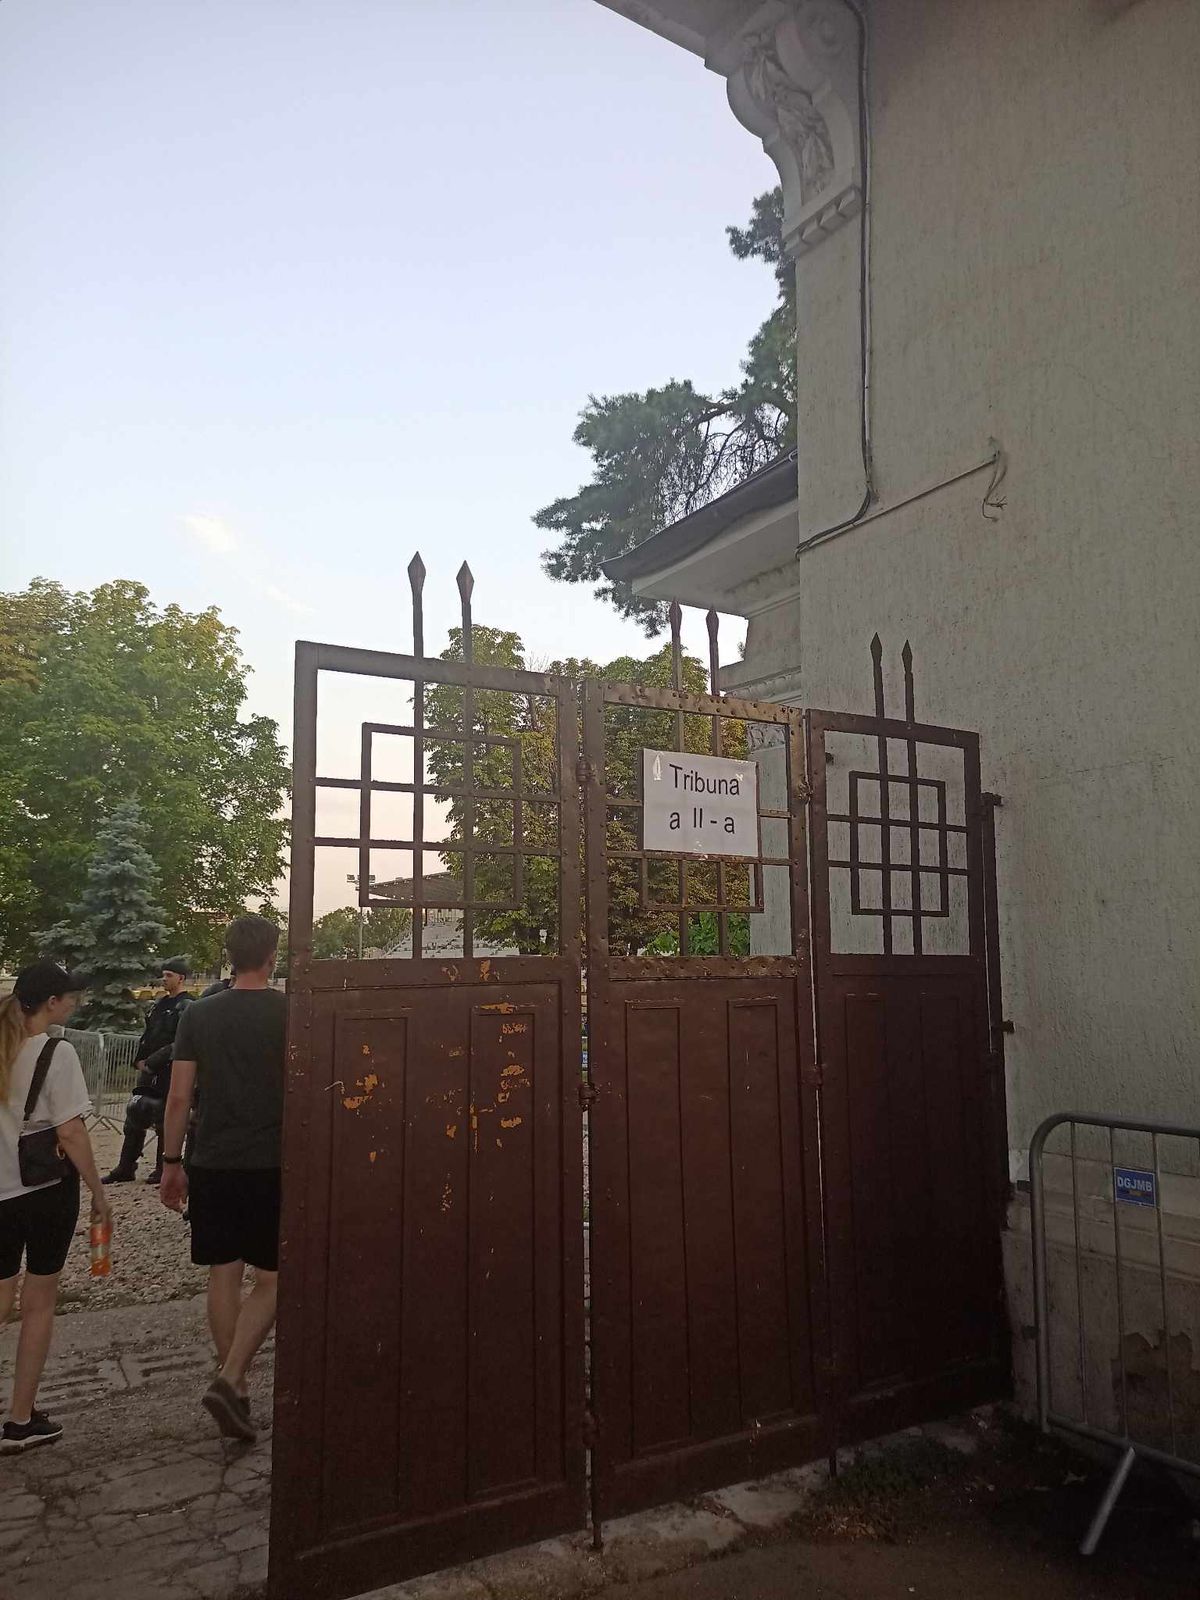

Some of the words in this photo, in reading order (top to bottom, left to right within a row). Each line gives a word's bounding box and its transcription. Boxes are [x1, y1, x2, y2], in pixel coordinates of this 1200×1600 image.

[669, 763, 740, 796] Tribuna
[669, 811, 681, 830] a
[1117, 1176, 1153, 1192] DGJMB
